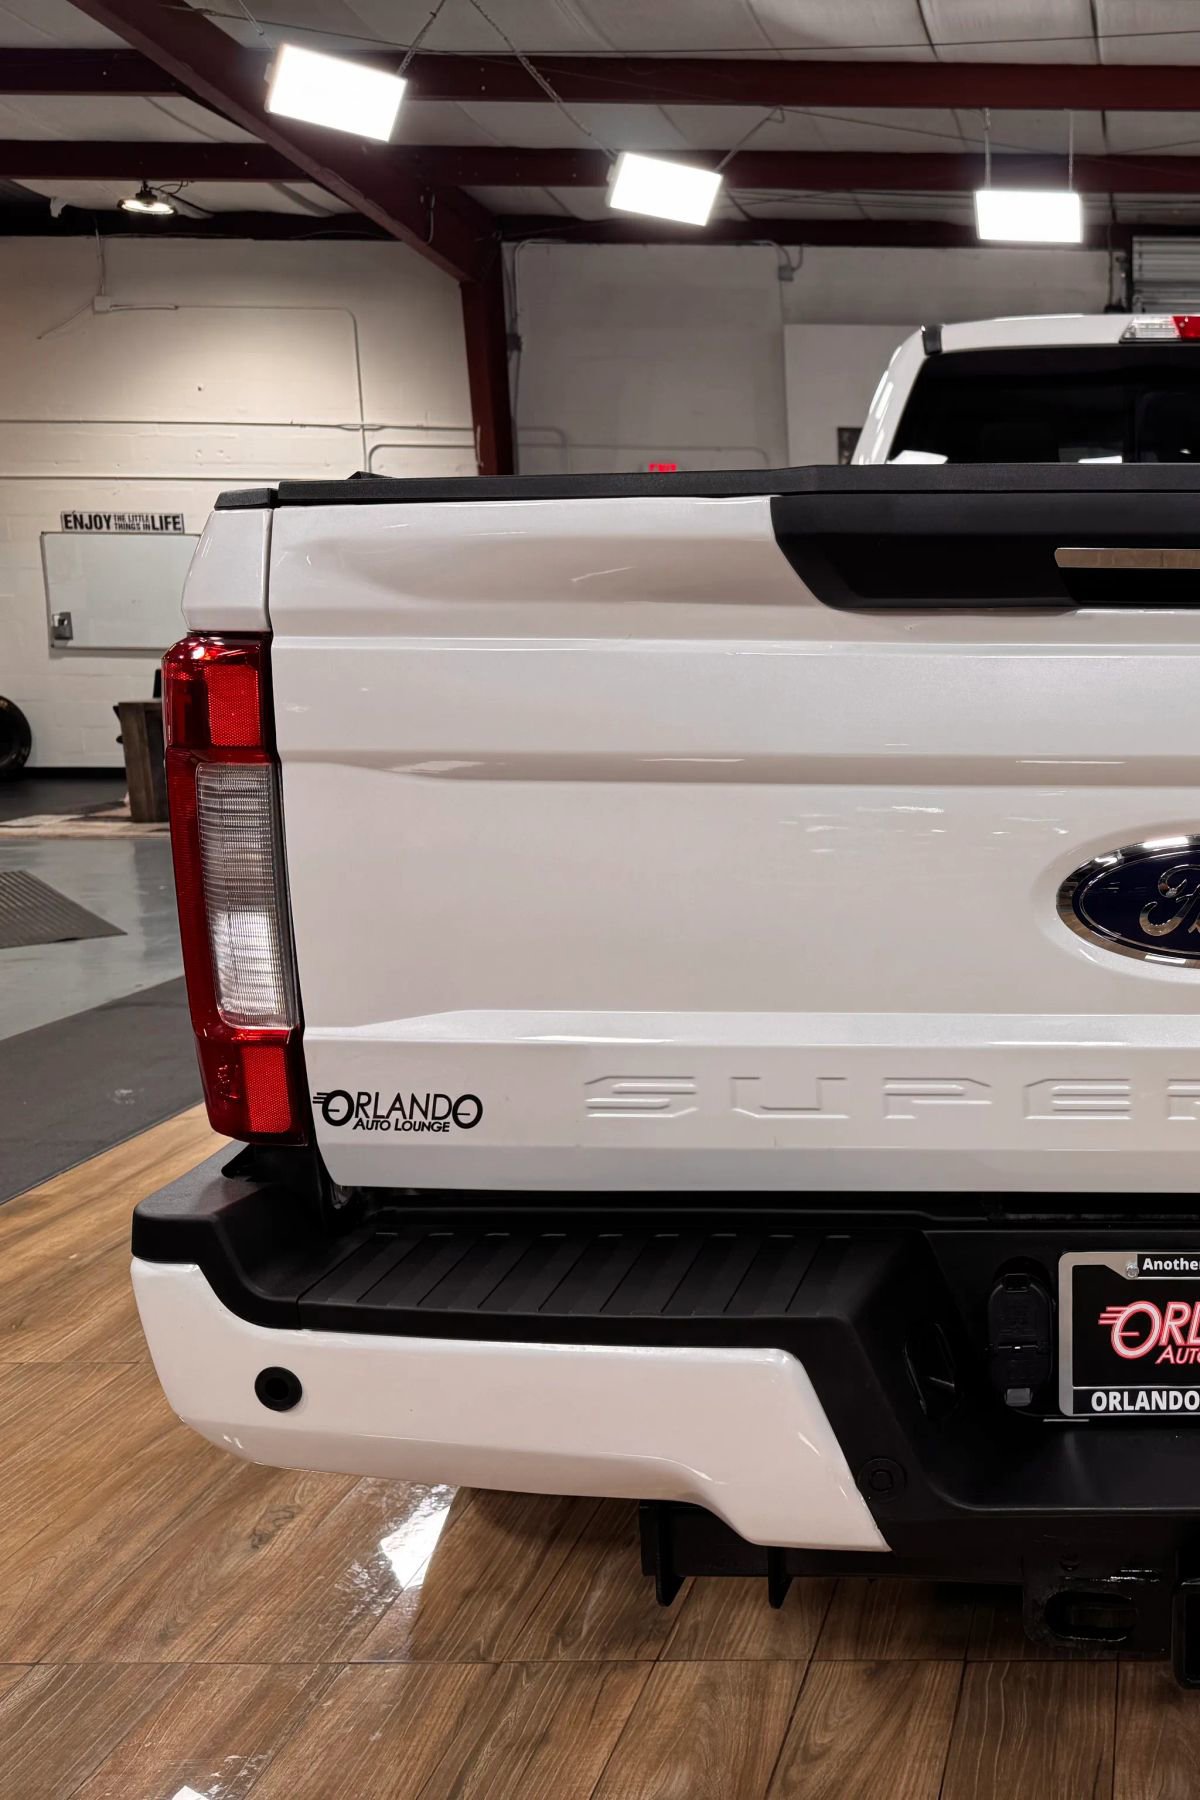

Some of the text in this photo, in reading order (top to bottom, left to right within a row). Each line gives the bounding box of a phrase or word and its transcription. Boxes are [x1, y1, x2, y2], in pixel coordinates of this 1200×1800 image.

[63, 514, 112, 530] ENJOY
[114, 514, 150, 523] THE LITTLE
[151, 515, 181, 531] LIFE
[114, 523, 151, 531] THINGS IN
[320, 1089, 484, 1129] ORLANDO
[352, 1117, 451, 1133] AUTO LOUNGE
[1091, 1389, 1200, 1412] ORLANDO
